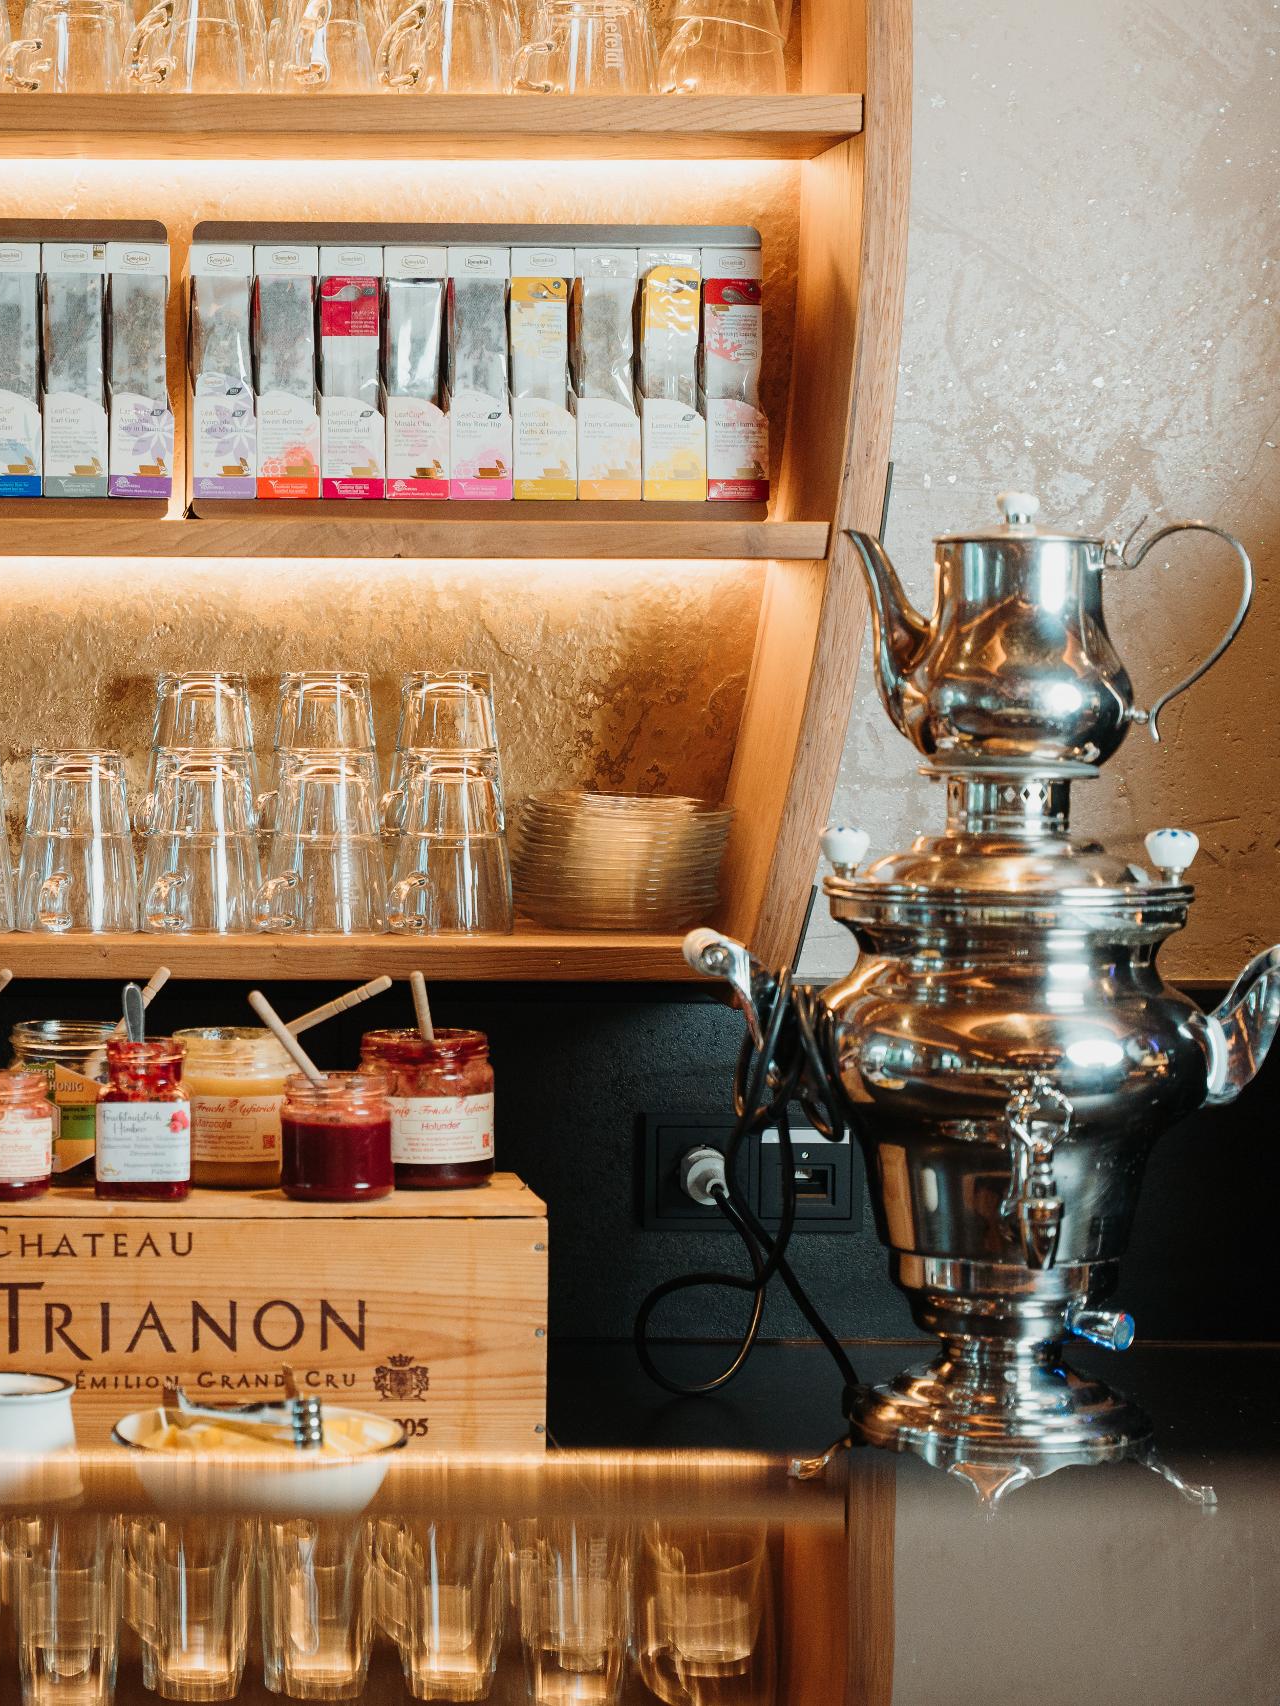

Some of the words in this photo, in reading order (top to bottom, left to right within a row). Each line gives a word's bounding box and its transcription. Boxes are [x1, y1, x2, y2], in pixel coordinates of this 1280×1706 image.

[49, 1081, 84, 1091] HONIG
[421, 1121, 461, 1131] Holunder
[196, 1370, 286, 1389] GRAND
[304, 1370, 357, 1389] CRU
